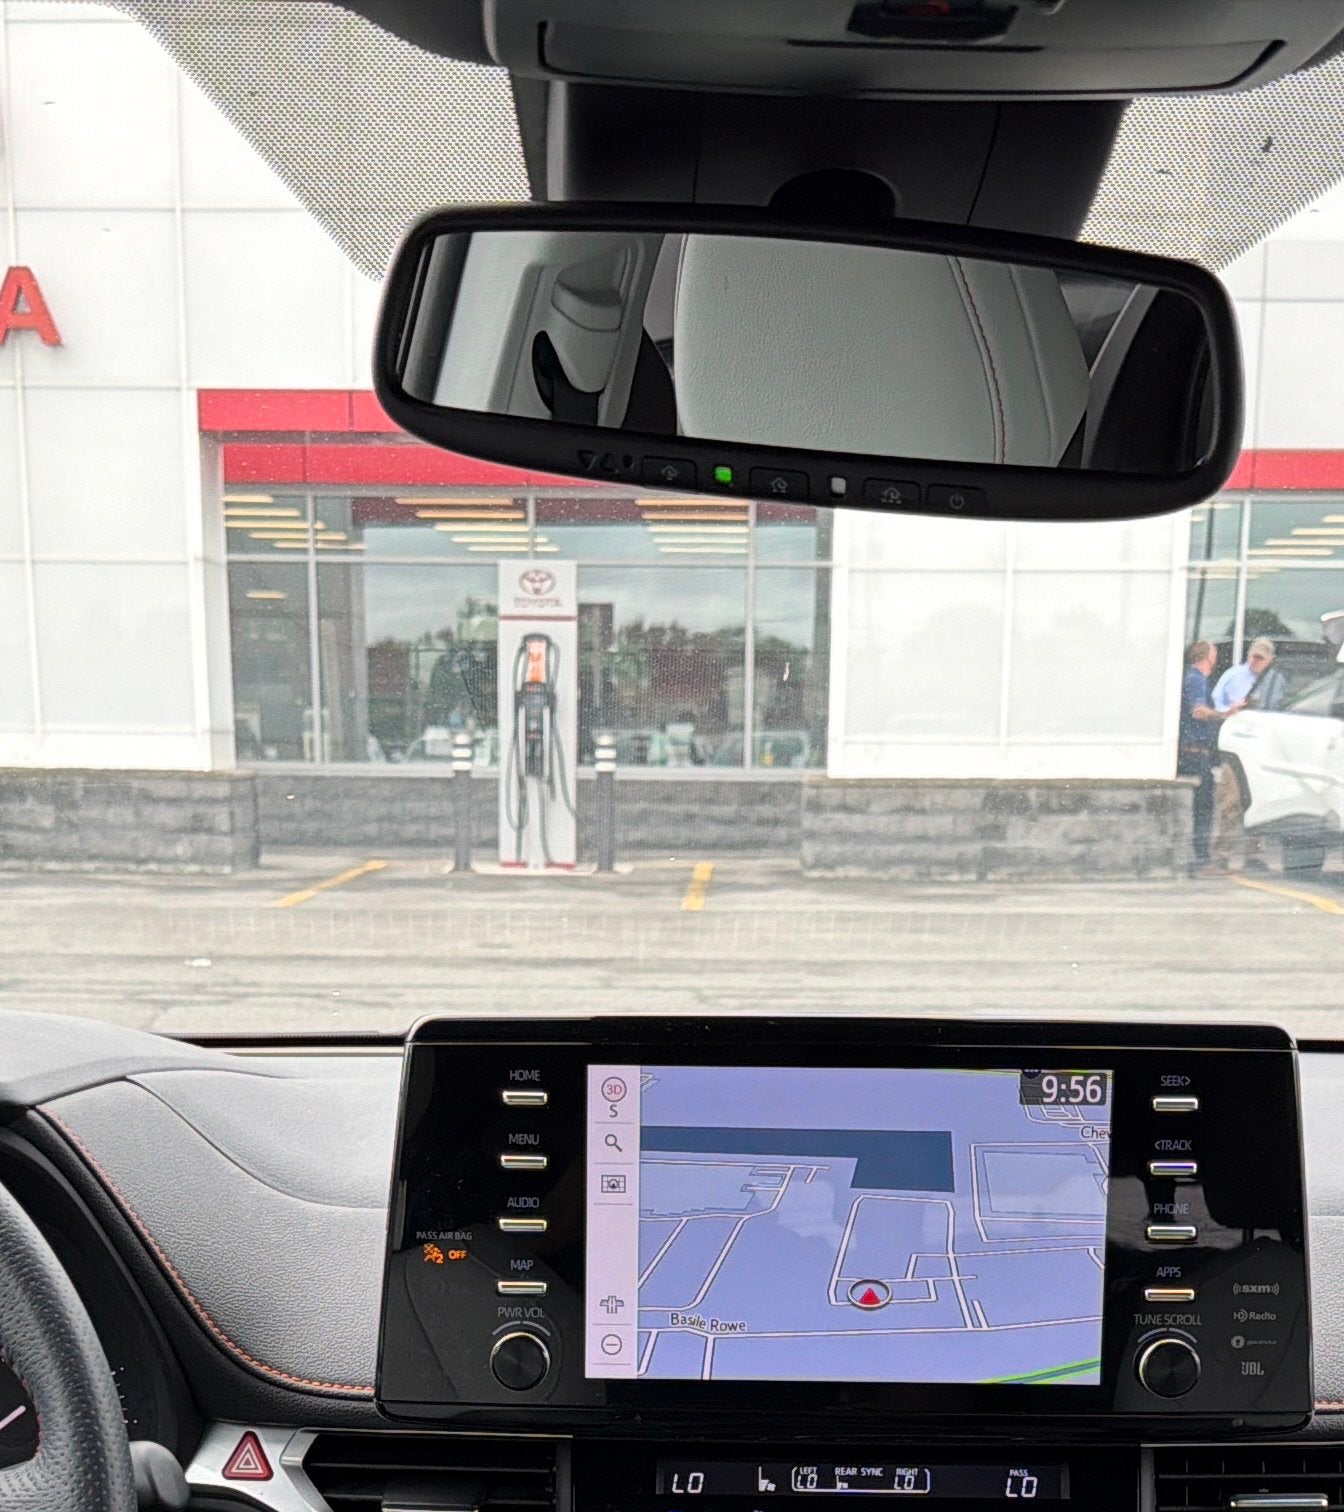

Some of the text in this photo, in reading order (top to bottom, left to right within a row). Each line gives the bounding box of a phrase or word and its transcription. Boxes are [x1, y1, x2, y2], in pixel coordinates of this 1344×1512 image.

[509, 1070, 540, 1081] HOME
[606, 1084, 622, 1095] 3D
[1042, 1075, 1102, 1103] 9:56
[609, 1105, 618, 1118] S
[509, 1134, 539, 1145] MENU
[506, 1197, 539, 1208] AUDIO
[1154, 1203, 1189, 1214] PHONE
[416, 1232, 472, 1240] PASS AIR BAG
[449, 1250, 467, 1260] OFF
[510, 1259, 533, 1270] MAP
[1156, 1267, 1181, 1278] APPS
[498, 1307, 544, 1318] PWR VOL
[671, 1313, 746, 1331] Basile Rowe
[1134, 1314, 1201, 1325] TUNE SCROLL
[1241, 1361, 1265, 1376] JBL
[800, 1467, 817, 1475] LEFT
[835, 1467, 884, 1476] REAR SYNC
[896, 1468, 918, 1476] RIGHT
[1009, 1469, 1028, 1477] PASS
